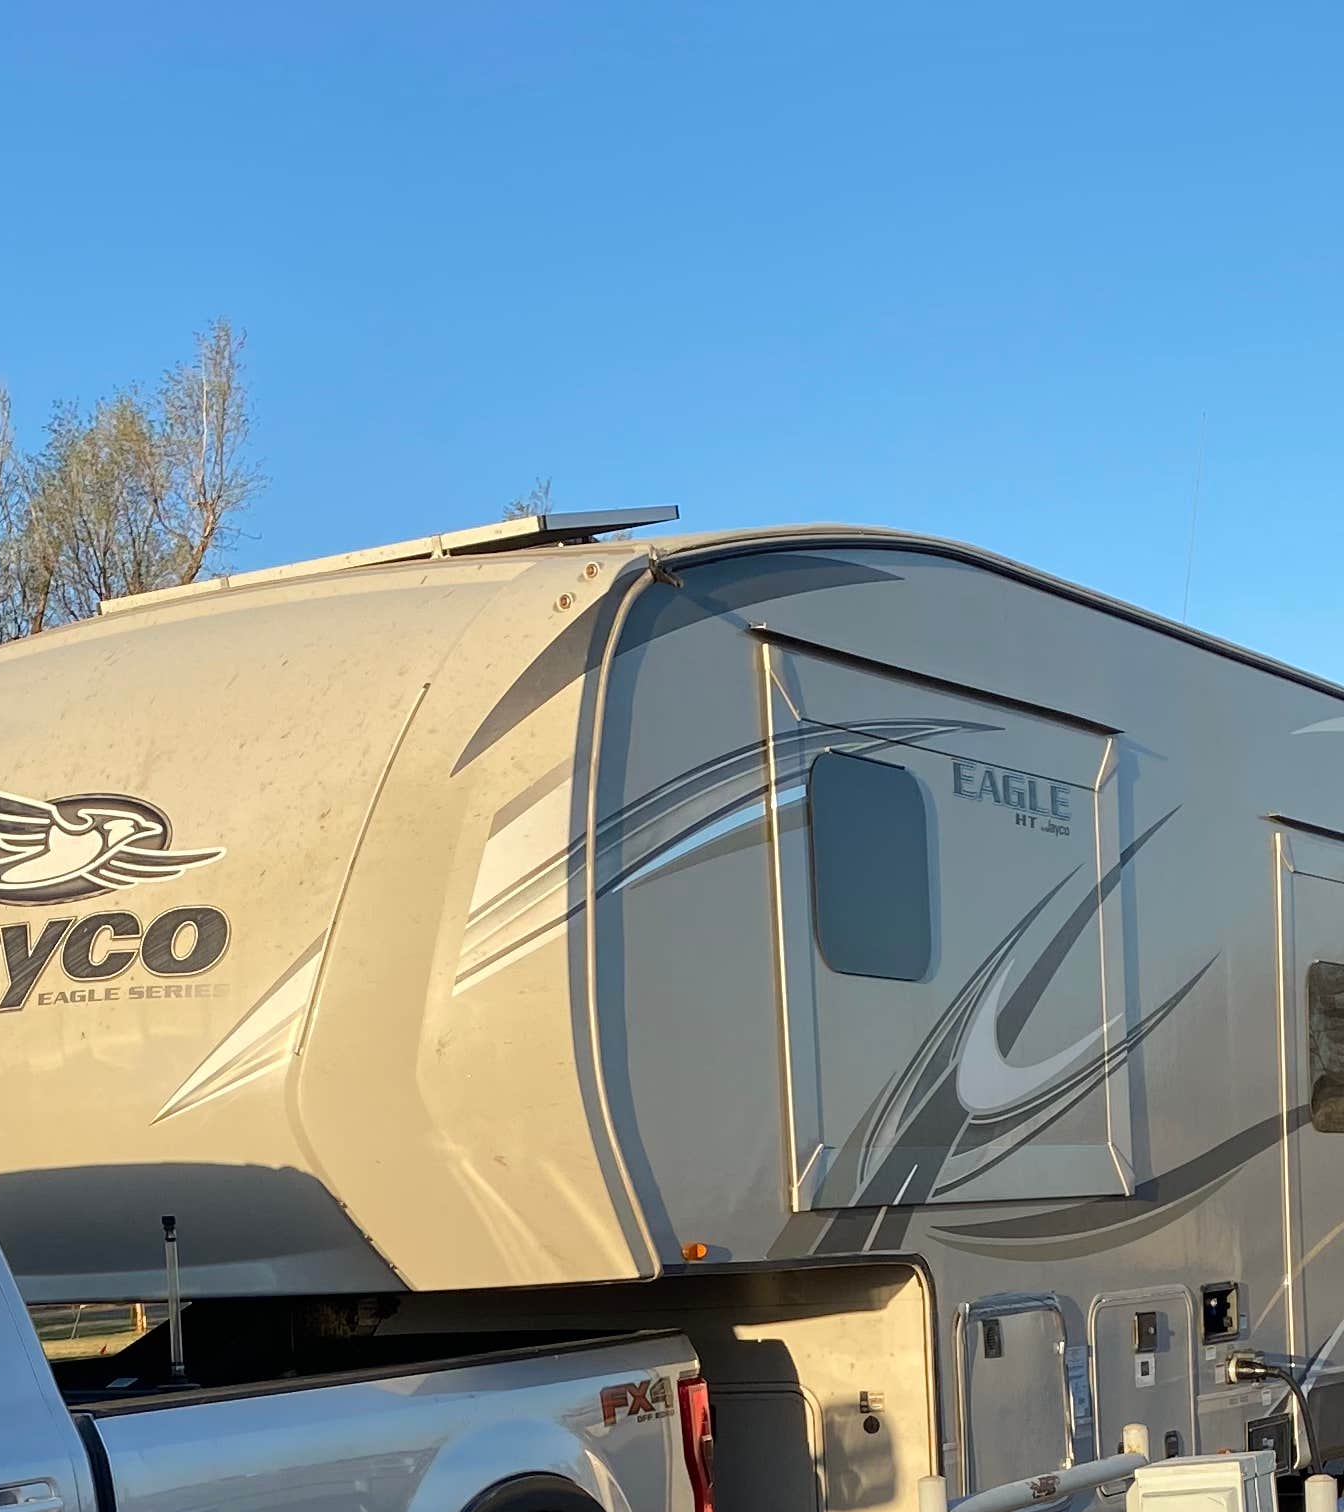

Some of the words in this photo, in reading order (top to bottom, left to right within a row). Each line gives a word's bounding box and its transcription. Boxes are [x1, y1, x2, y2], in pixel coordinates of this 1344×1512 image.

[951, 759, 1072, 821] EAGLE
[1015, 813, 1038, 829] HT
[38, 987, 122, 1006] EAGLE
[128, 984, 231, 1000] SERIES
[599, 1376, 674, 1428] FX4
